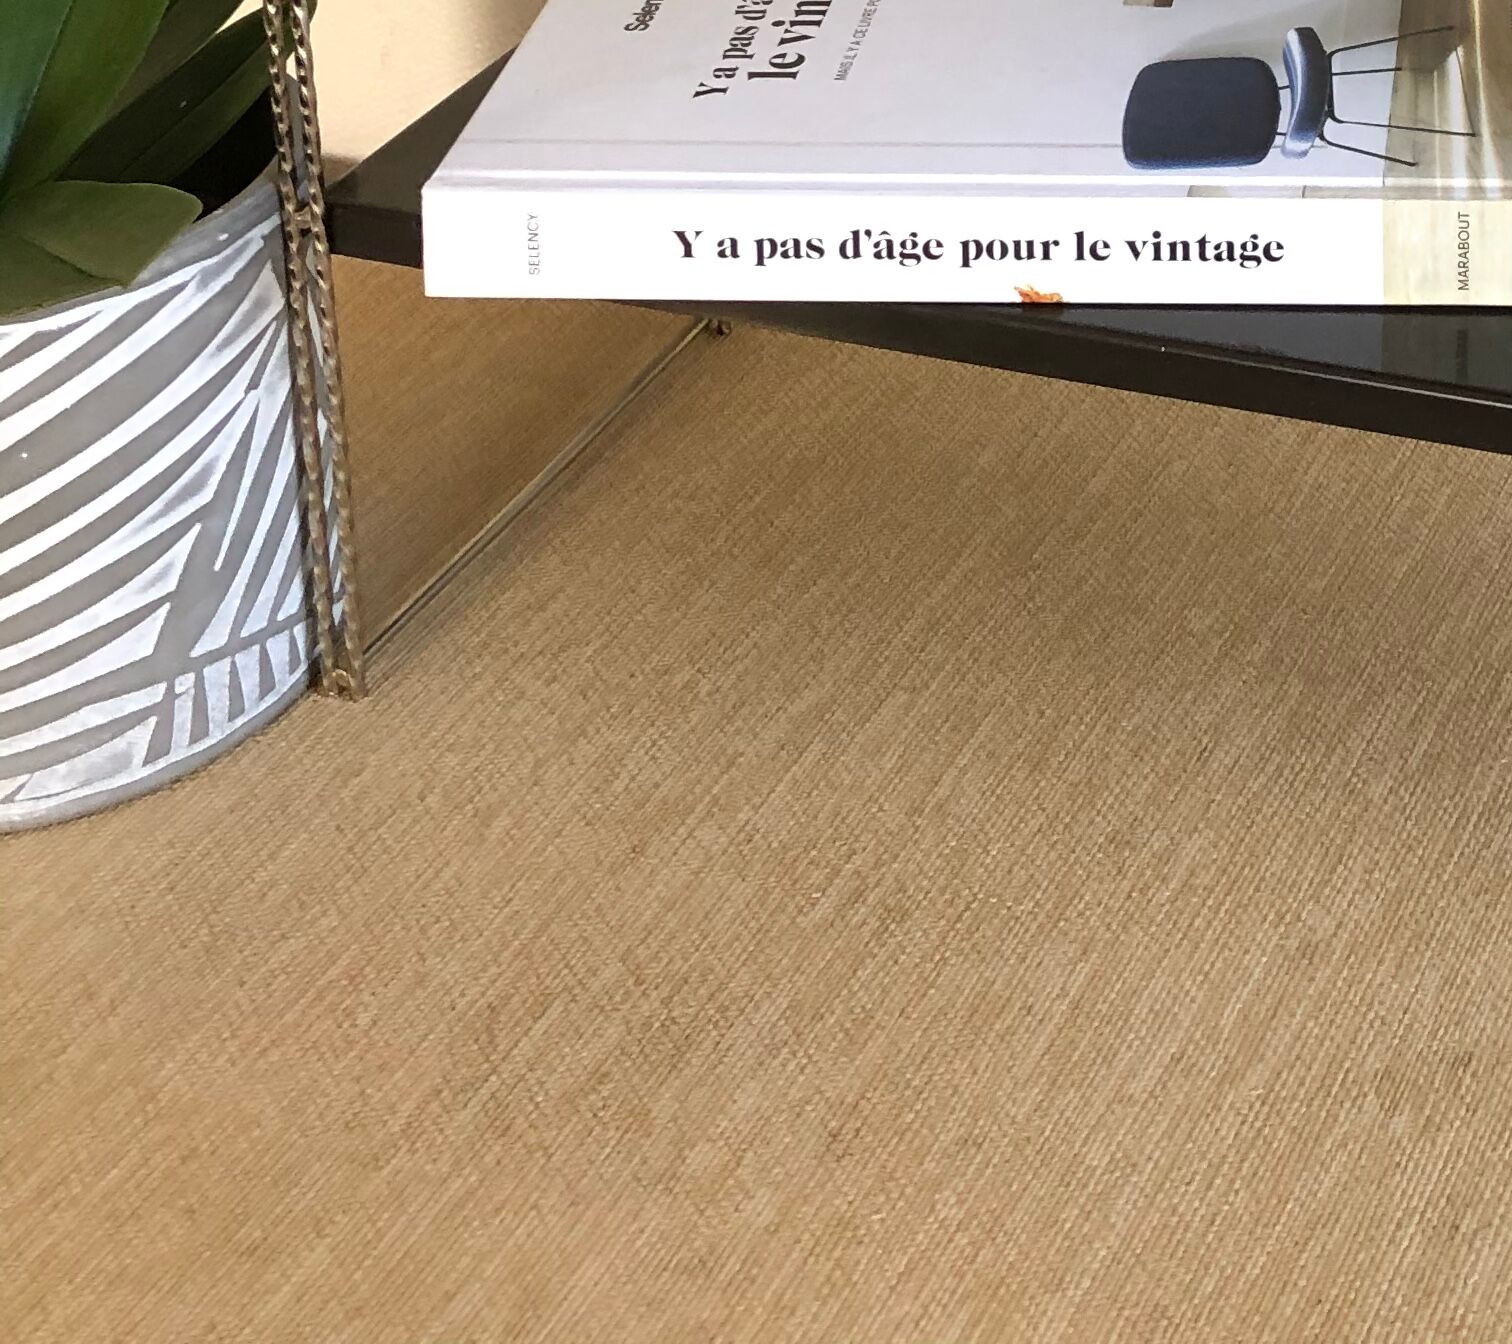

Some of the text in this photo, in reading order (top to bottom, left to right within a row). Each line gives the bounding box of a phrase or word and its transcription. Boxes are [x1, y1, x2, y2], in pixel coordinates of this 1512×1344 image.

[722, 25, 759, 60] pas
[713, 66, 739, 79] a
[747, 52, 806, 80] le
[693, 81, 729, 98] Y
[527, 212, 541, 276] SELENCY
[672, 230, 703, 259] Y
[716, 237, 741, 259] a
[754, 237, 826, 267] pas
[959, 239, 1060, 268] pour
[1073, 230, 1111, 262] le
[1124, 230, 1285, 269] vintage
[1457, 210, 1471, 291] MARABOUT
